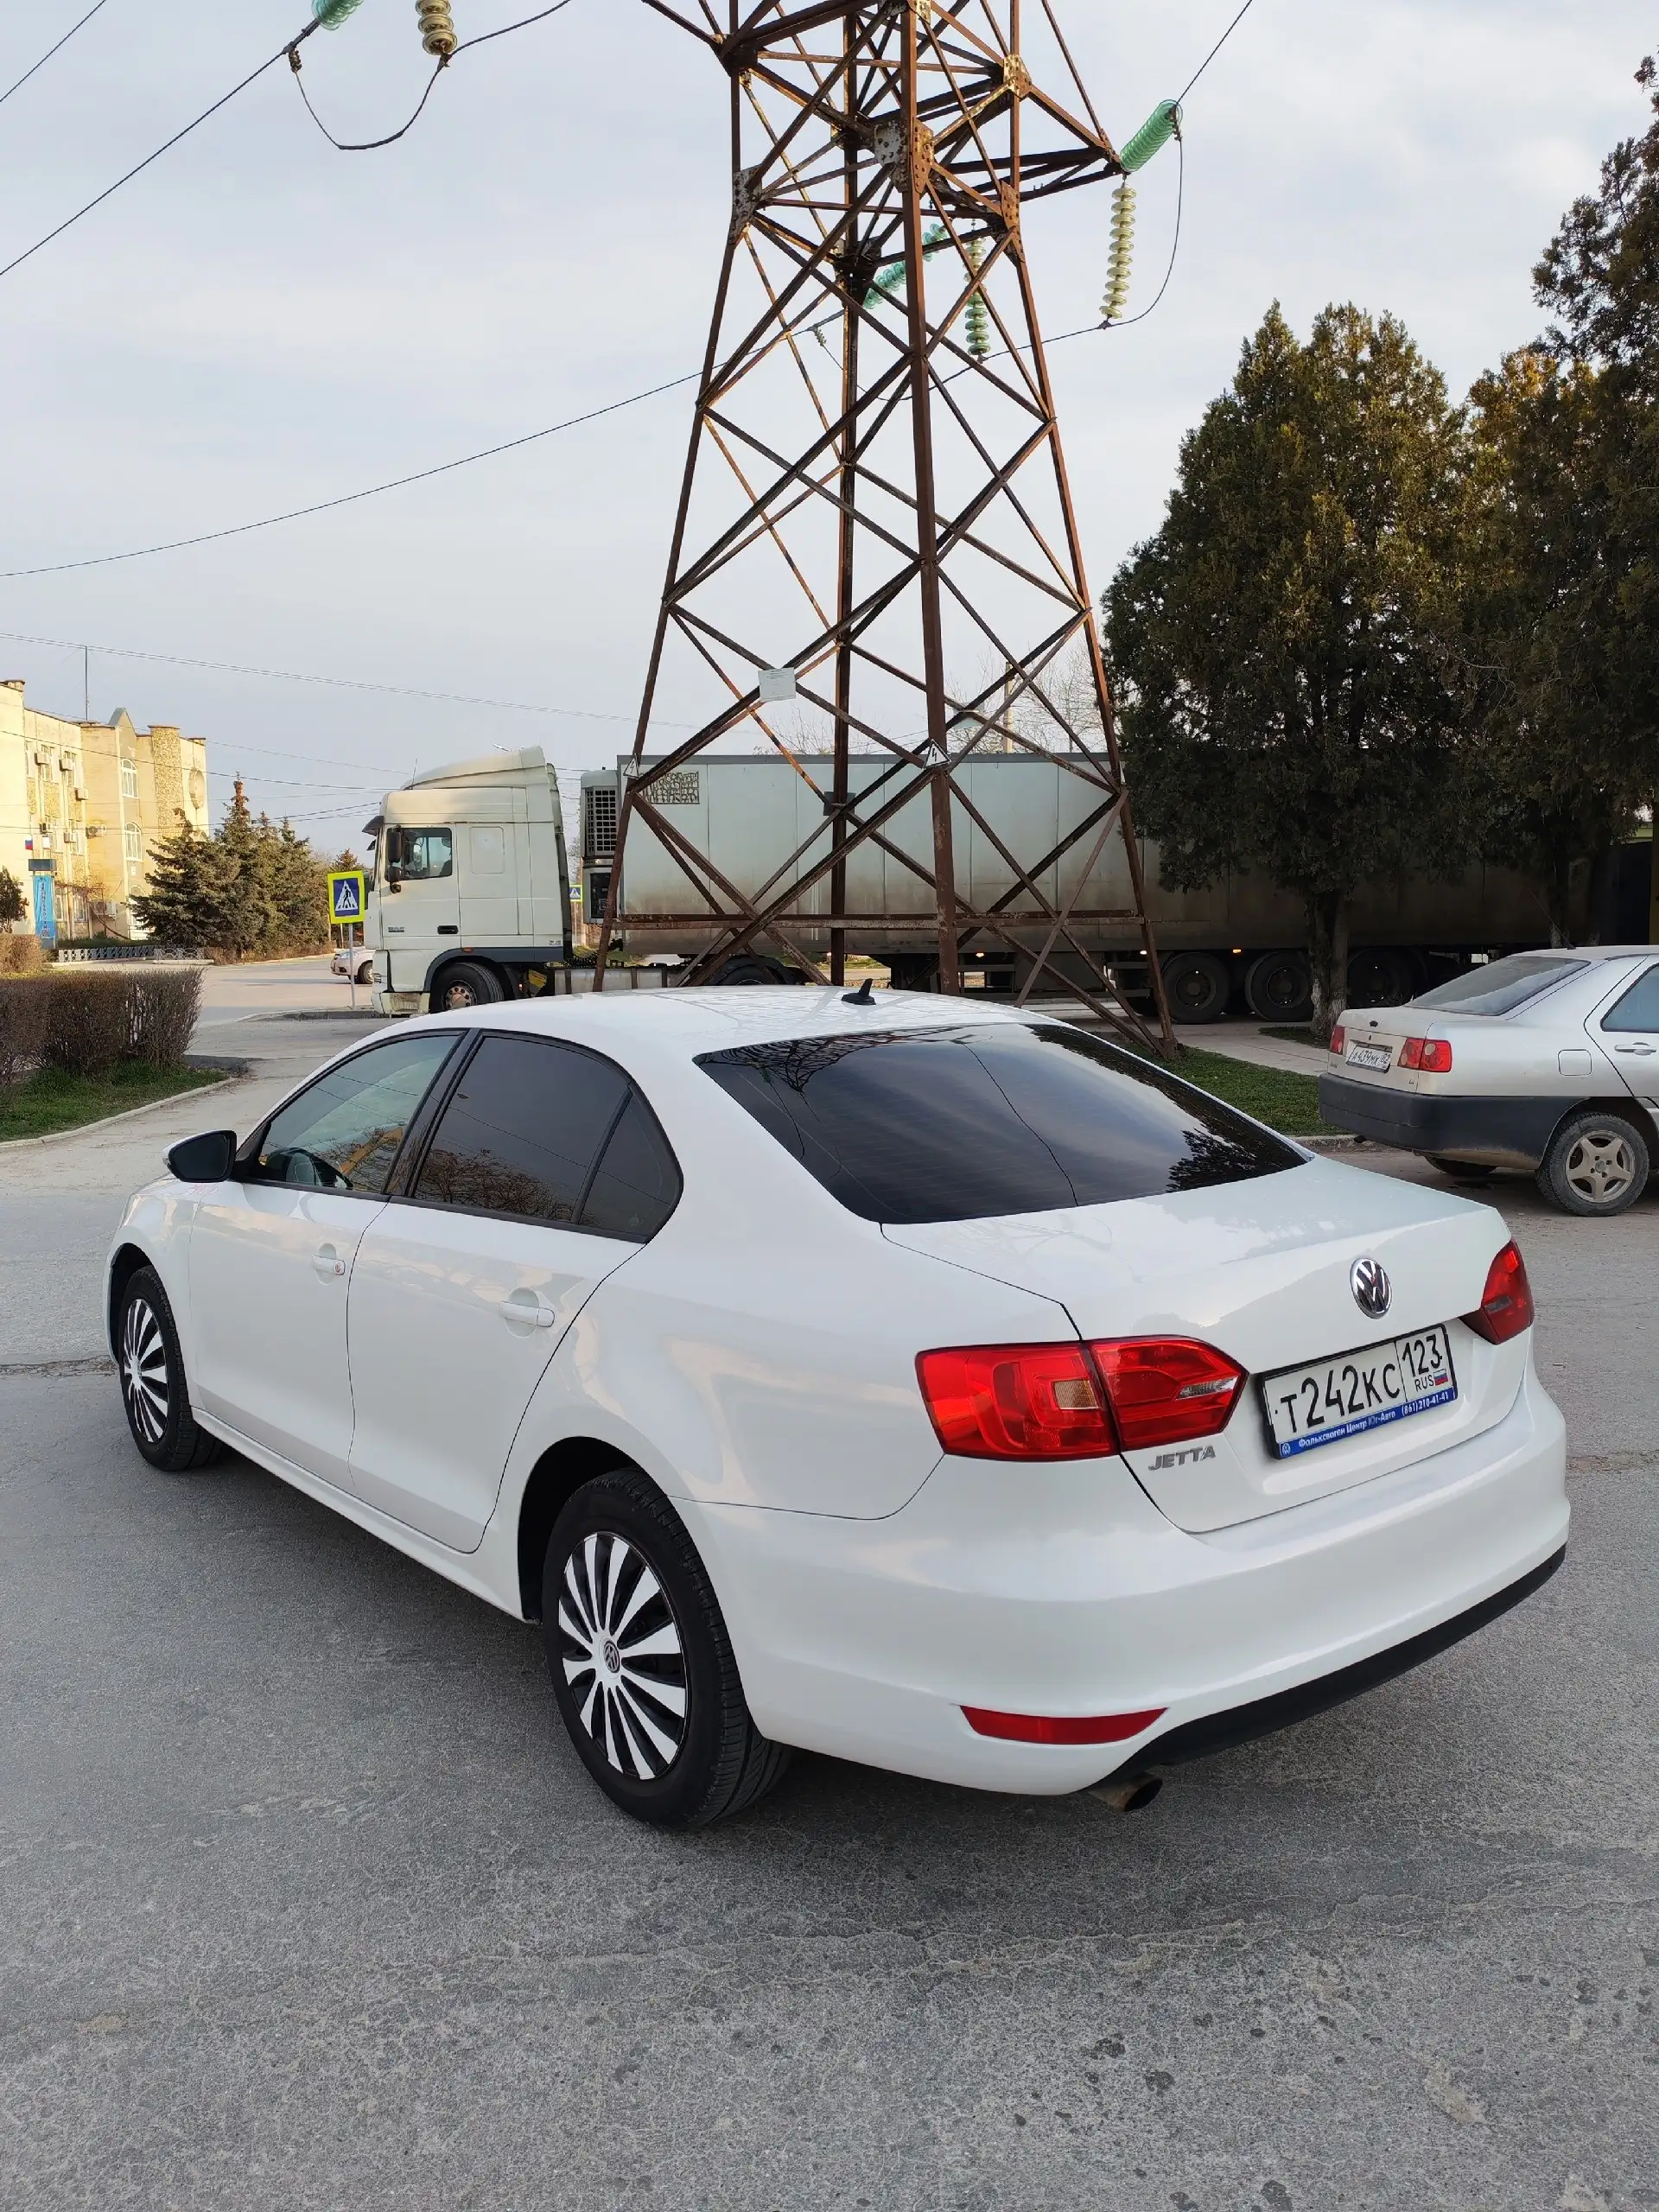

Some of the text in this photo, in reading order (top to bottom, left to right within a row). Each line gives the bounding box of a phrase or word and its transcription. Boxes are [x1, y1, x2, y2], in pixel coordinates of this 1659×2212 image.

[1402, 1334, 1442, 1376] 123
[1414, 1377, 1434, 1392] RUS
[1346, 1421, 1367, 1434] Центр
[1147, 1445, 1216, 1471] JETTA
